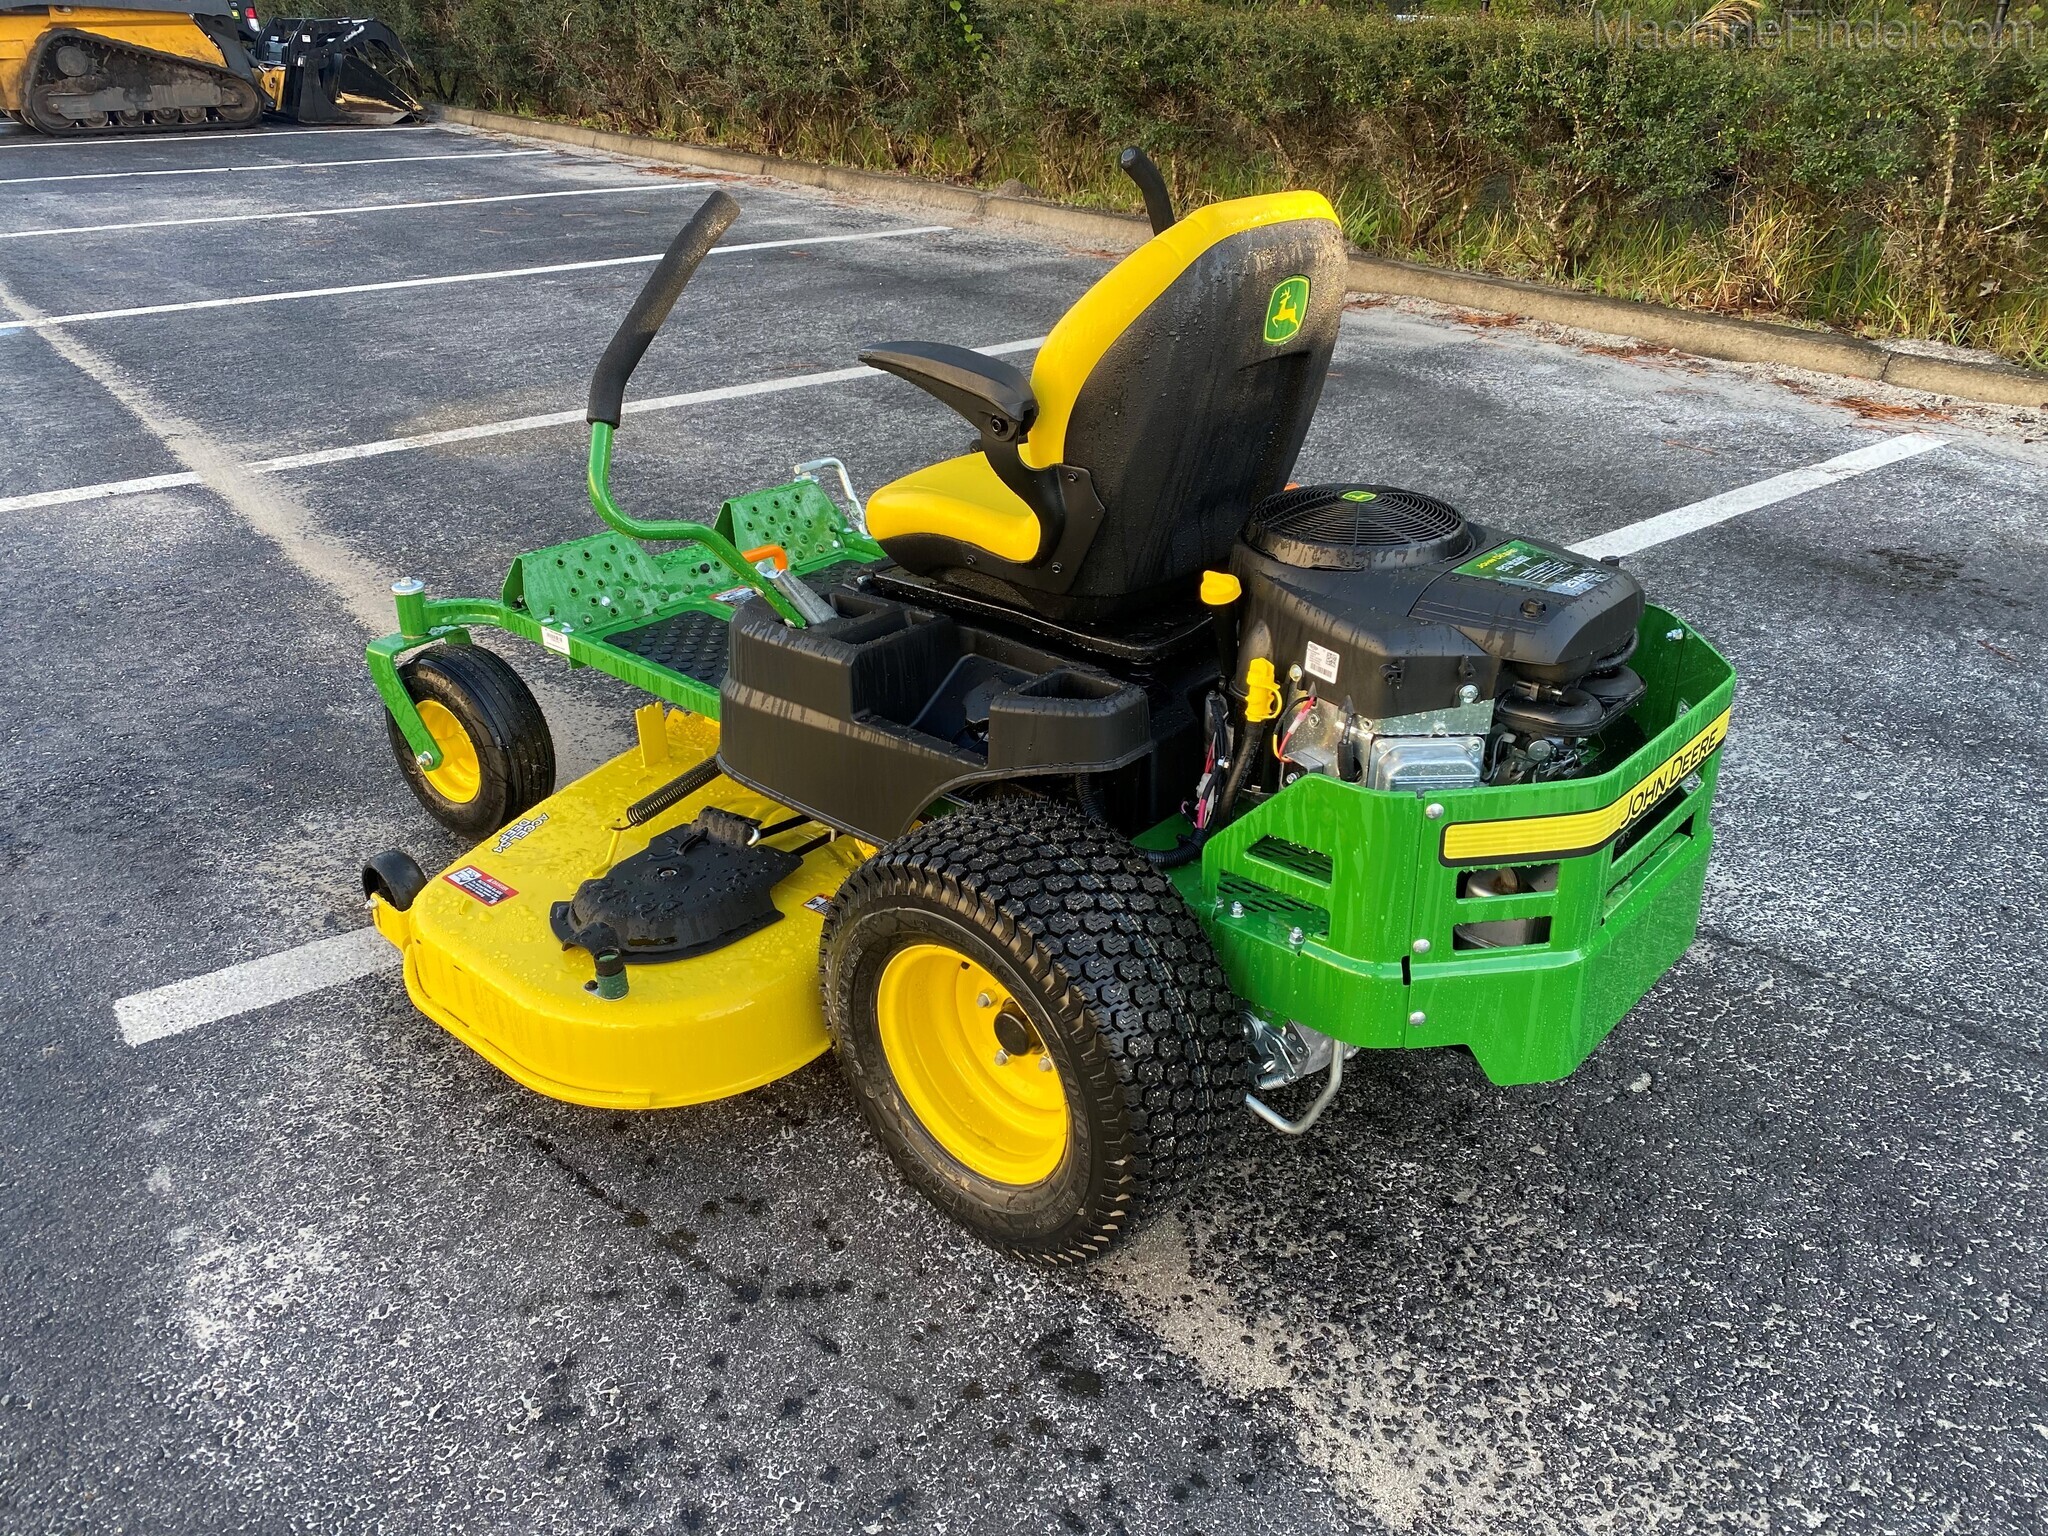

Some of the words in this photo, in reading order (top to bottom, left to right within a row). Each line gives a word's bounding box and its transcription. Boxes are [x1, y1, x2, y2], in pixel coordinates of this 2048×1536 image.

[1620, 771, 1668, 828] JOHN
[1669, 727, 1718, 787] DEERE
[499, 818, 531, 842] DEEP
[510, 812, 550, 840] ACCEL
[492, 841, 513, 853] 54
